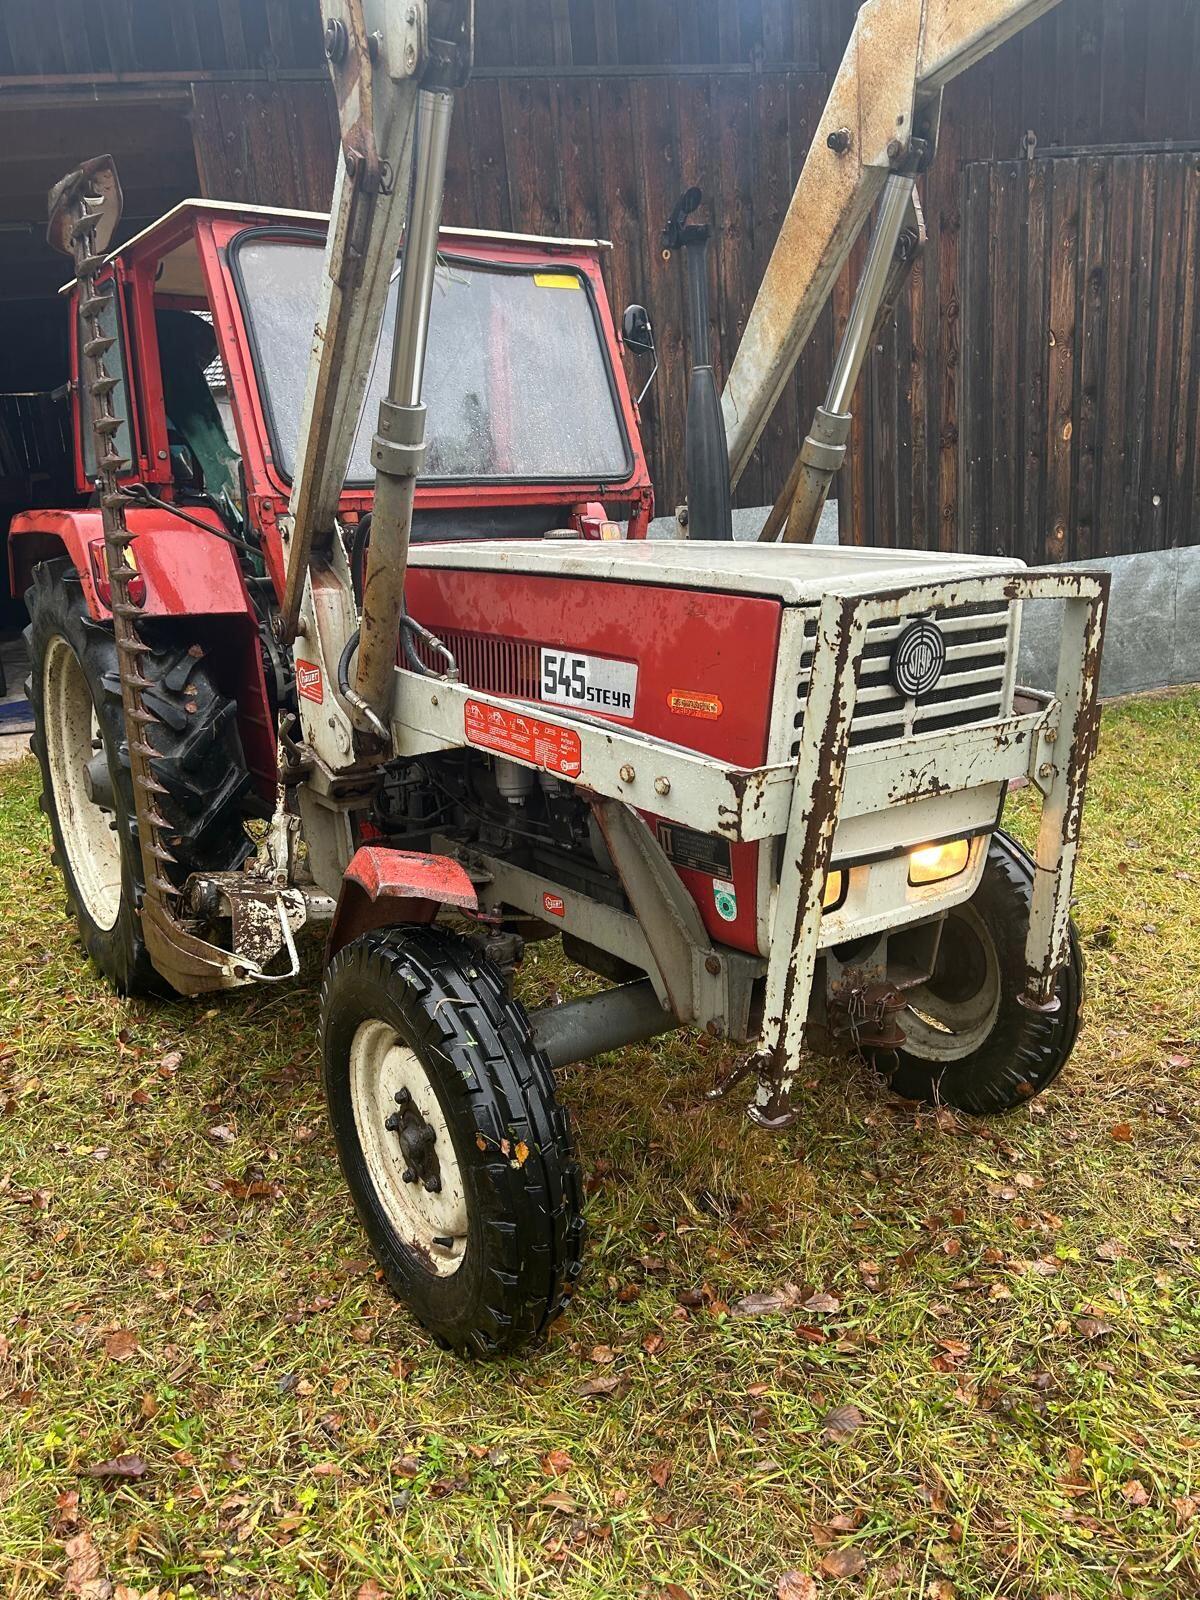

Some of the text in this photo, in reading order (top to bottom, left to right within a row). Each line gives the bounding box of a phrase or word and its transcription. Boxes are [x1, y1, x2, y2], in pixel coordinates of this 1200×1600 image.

[544, 655, 631, 709] 545 STEYR
[909, 644, 932, 677] STEYR
